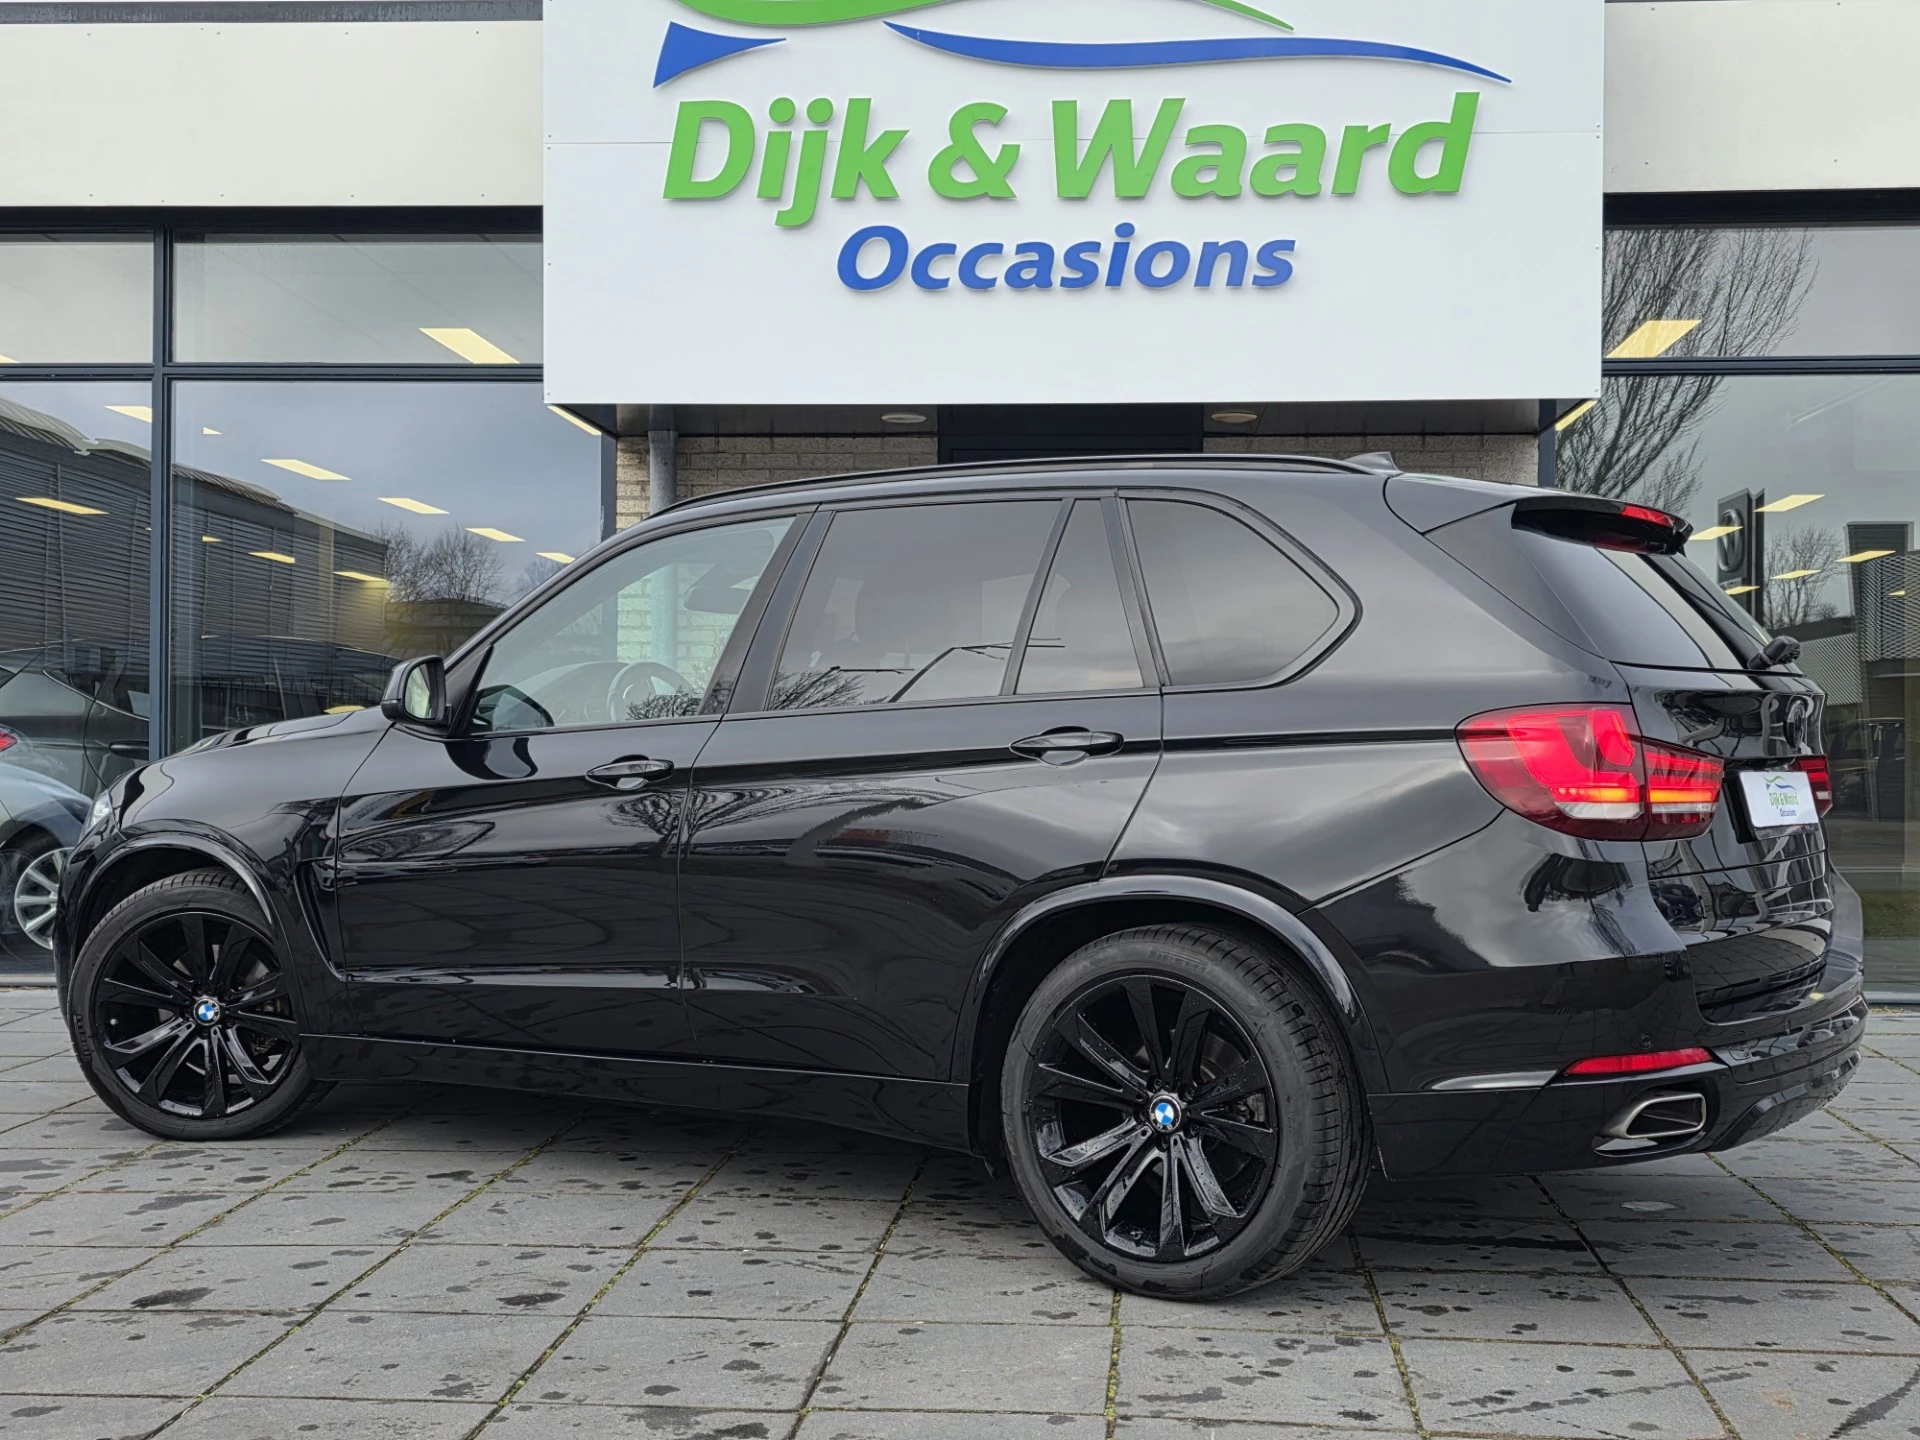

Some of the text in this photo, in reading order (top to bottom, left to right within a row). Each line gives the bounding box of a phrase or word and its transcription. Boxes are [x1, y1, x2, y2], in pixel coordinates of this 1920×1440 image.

[663, 92, 1480, 229] Dijk & Waard
[836, 222, 1297, 291] Occasions
